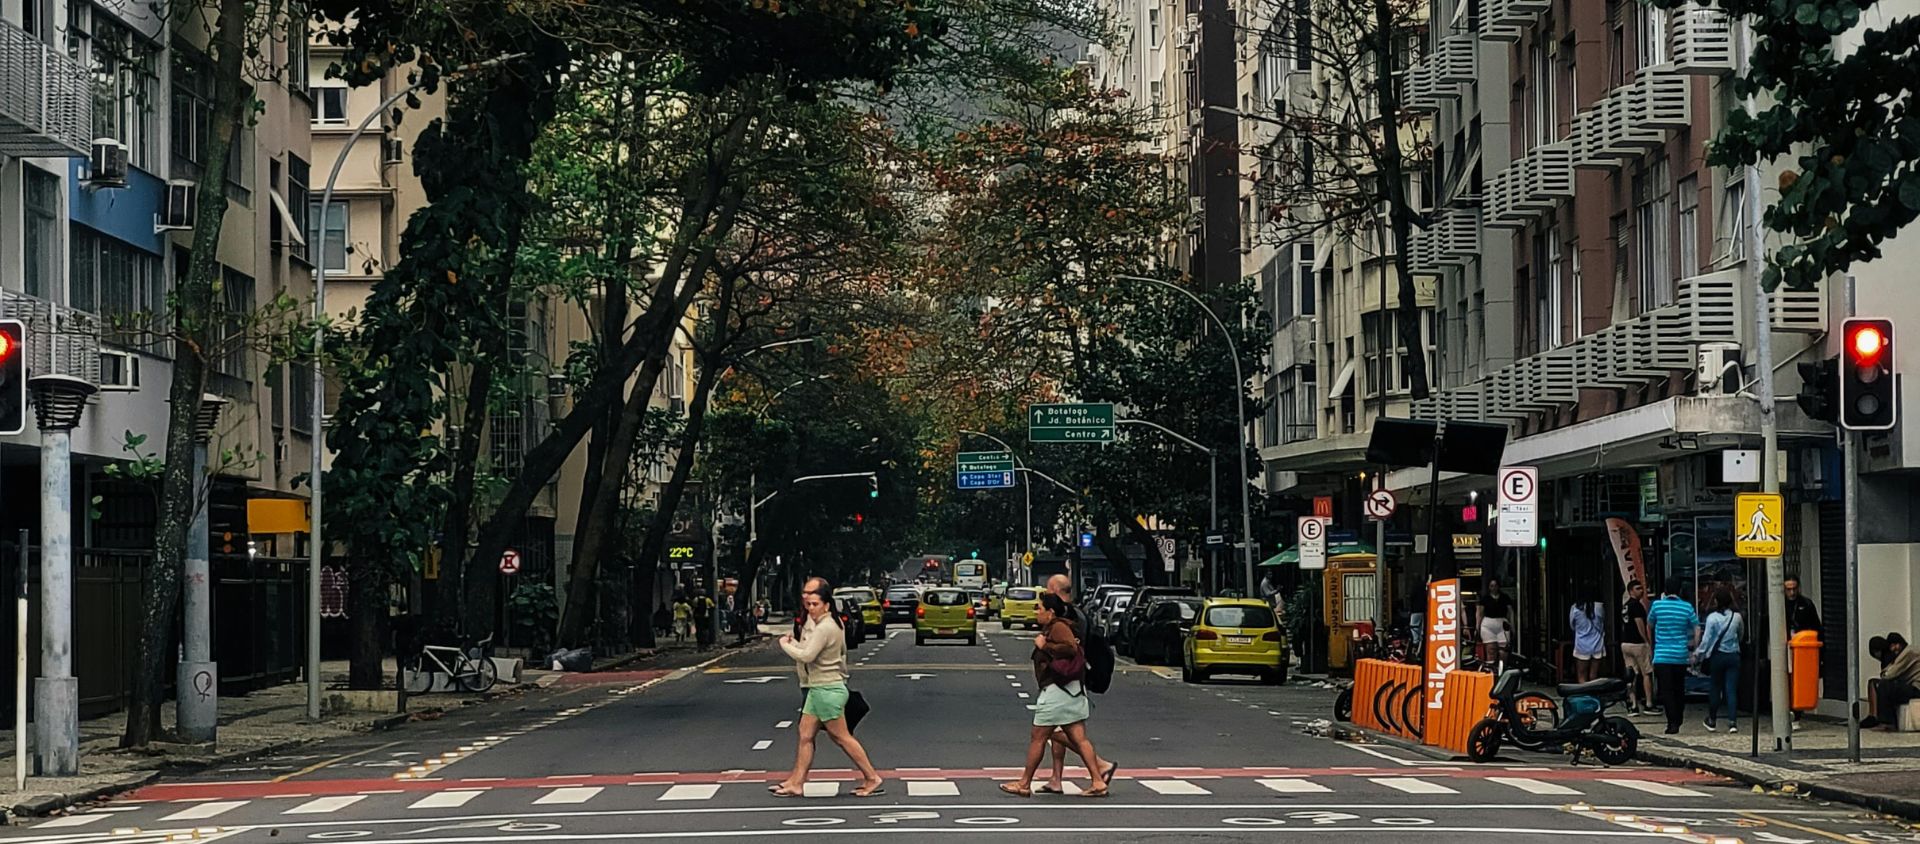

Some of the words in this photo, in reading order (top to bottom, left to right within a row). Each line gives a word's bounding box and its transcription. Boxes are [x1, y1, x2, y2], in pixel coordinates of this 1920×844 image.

[1048, 408, 1088, 416] Botafogo
[1065, 416, 1106, 424] Botânico
[1512, 477, 1523, 495] E
[1308, 523, 1316, 535] E
